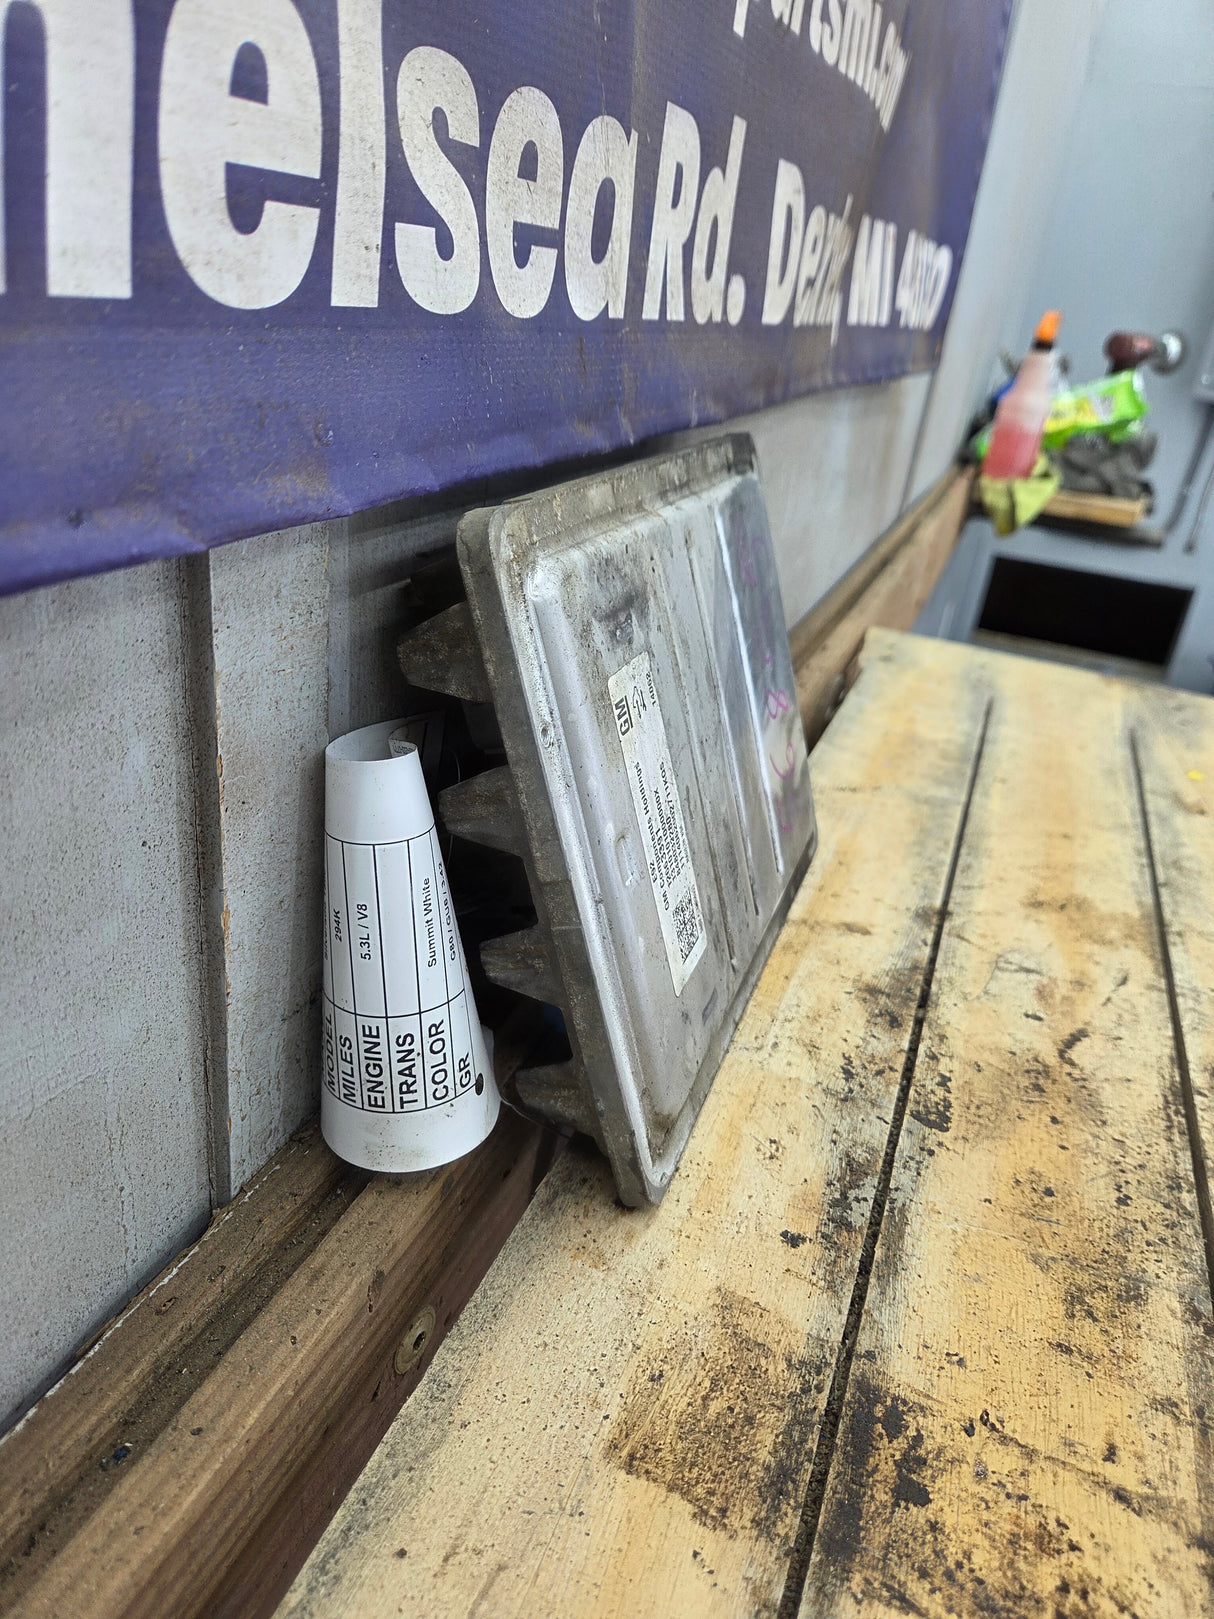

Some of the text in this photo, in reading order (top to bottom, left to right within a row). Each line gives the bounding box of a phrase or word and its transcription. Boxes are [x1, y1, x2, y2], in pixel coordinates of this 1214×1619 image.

[642, 100, 748, 326] Rd.
[614, 697, 630, 736] GM
[634, 761, 649, 816] Holdings
[356, 903, 369, 921] V8
[359, 932, 372, 961] 5.3L
[333, 907, 357, 1104] MILES 294K
[422, 877, 449, 1101] COLOR Summit White
[325, 1013, 336, 1092] MODEL
[361, 1023, 386, 1109] ENGINE
[395, 1032, 418, 1110] TRANS
[458, 1052, 472, 1089] GR
